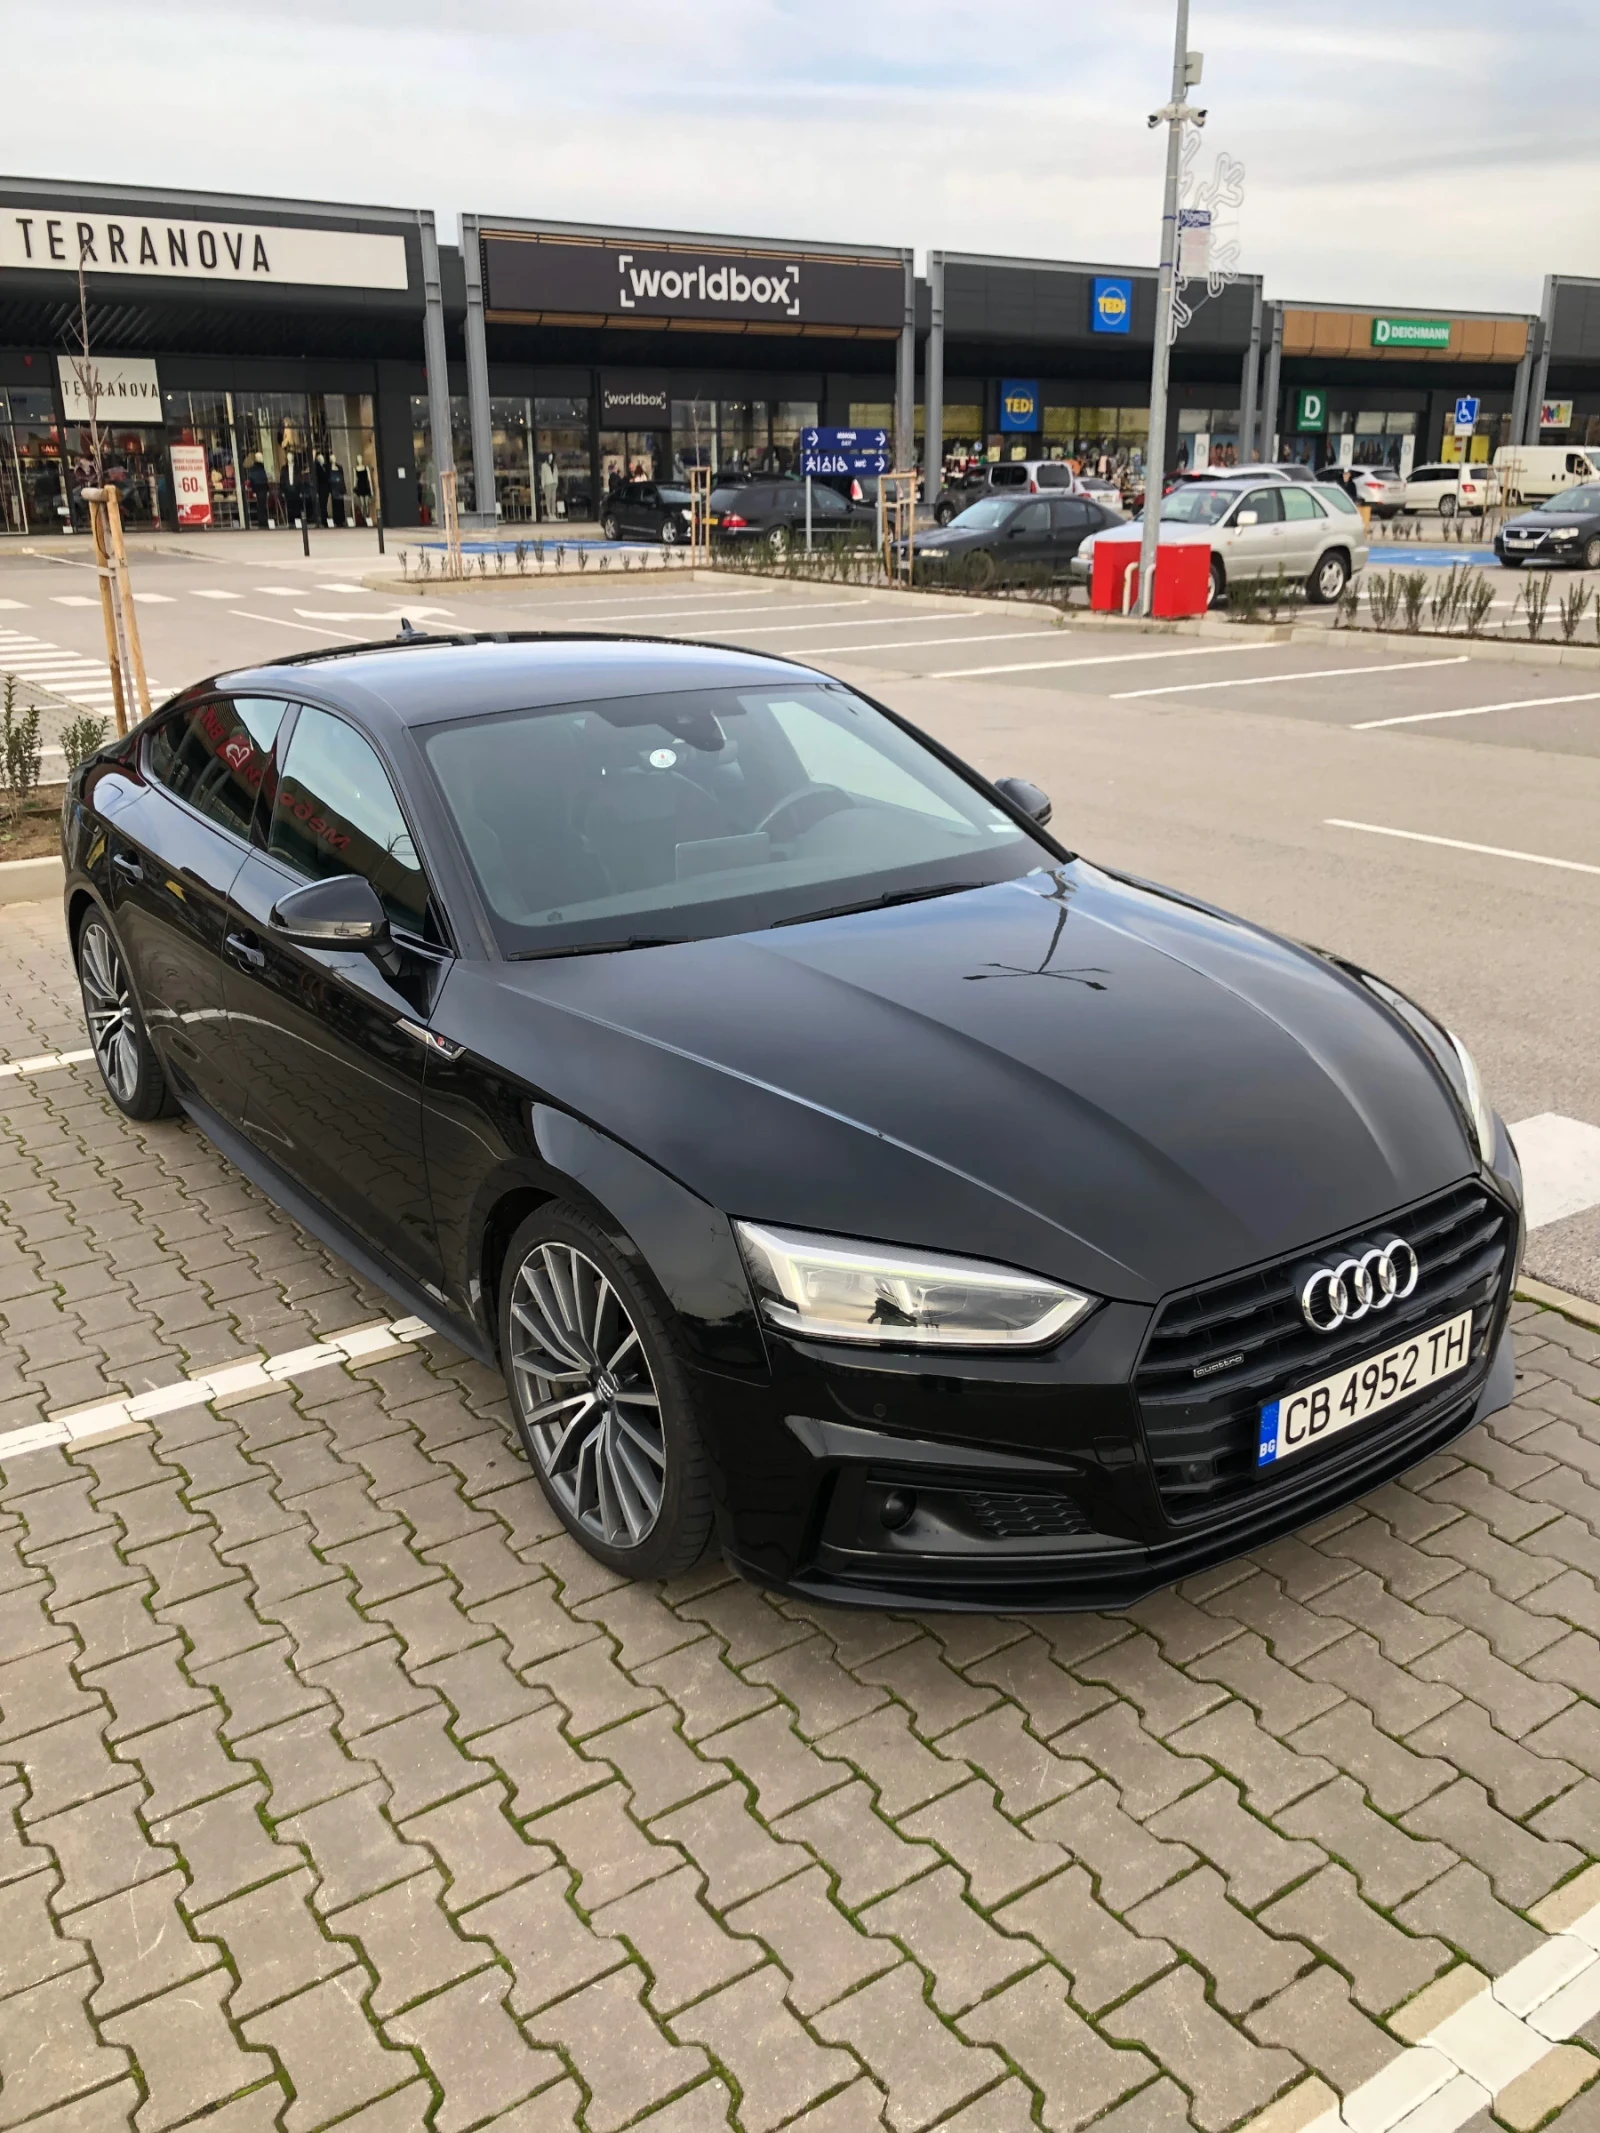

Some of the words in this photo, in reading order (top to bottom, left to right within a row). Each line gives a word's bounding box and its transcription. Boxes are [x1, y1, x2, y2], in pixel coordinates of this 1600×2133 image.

[16, 218, 270, 272] TERRANOVA
[629, 265, 791, 304] worldbox
[1391, 326, 1449, 340] DEICHMANN
[62, 381, 158, 398] TERANOVA
[608, 392, 662, 406] worldbox
[1305, 395, 1321, 419] D
[1285, 1386, 1330, 1445] CB
[1340, 1344, 1419, 1417] 4952
[1428, 1319, 1466, 1375] TH
[1259, 1439, 1276, 1458] BG
